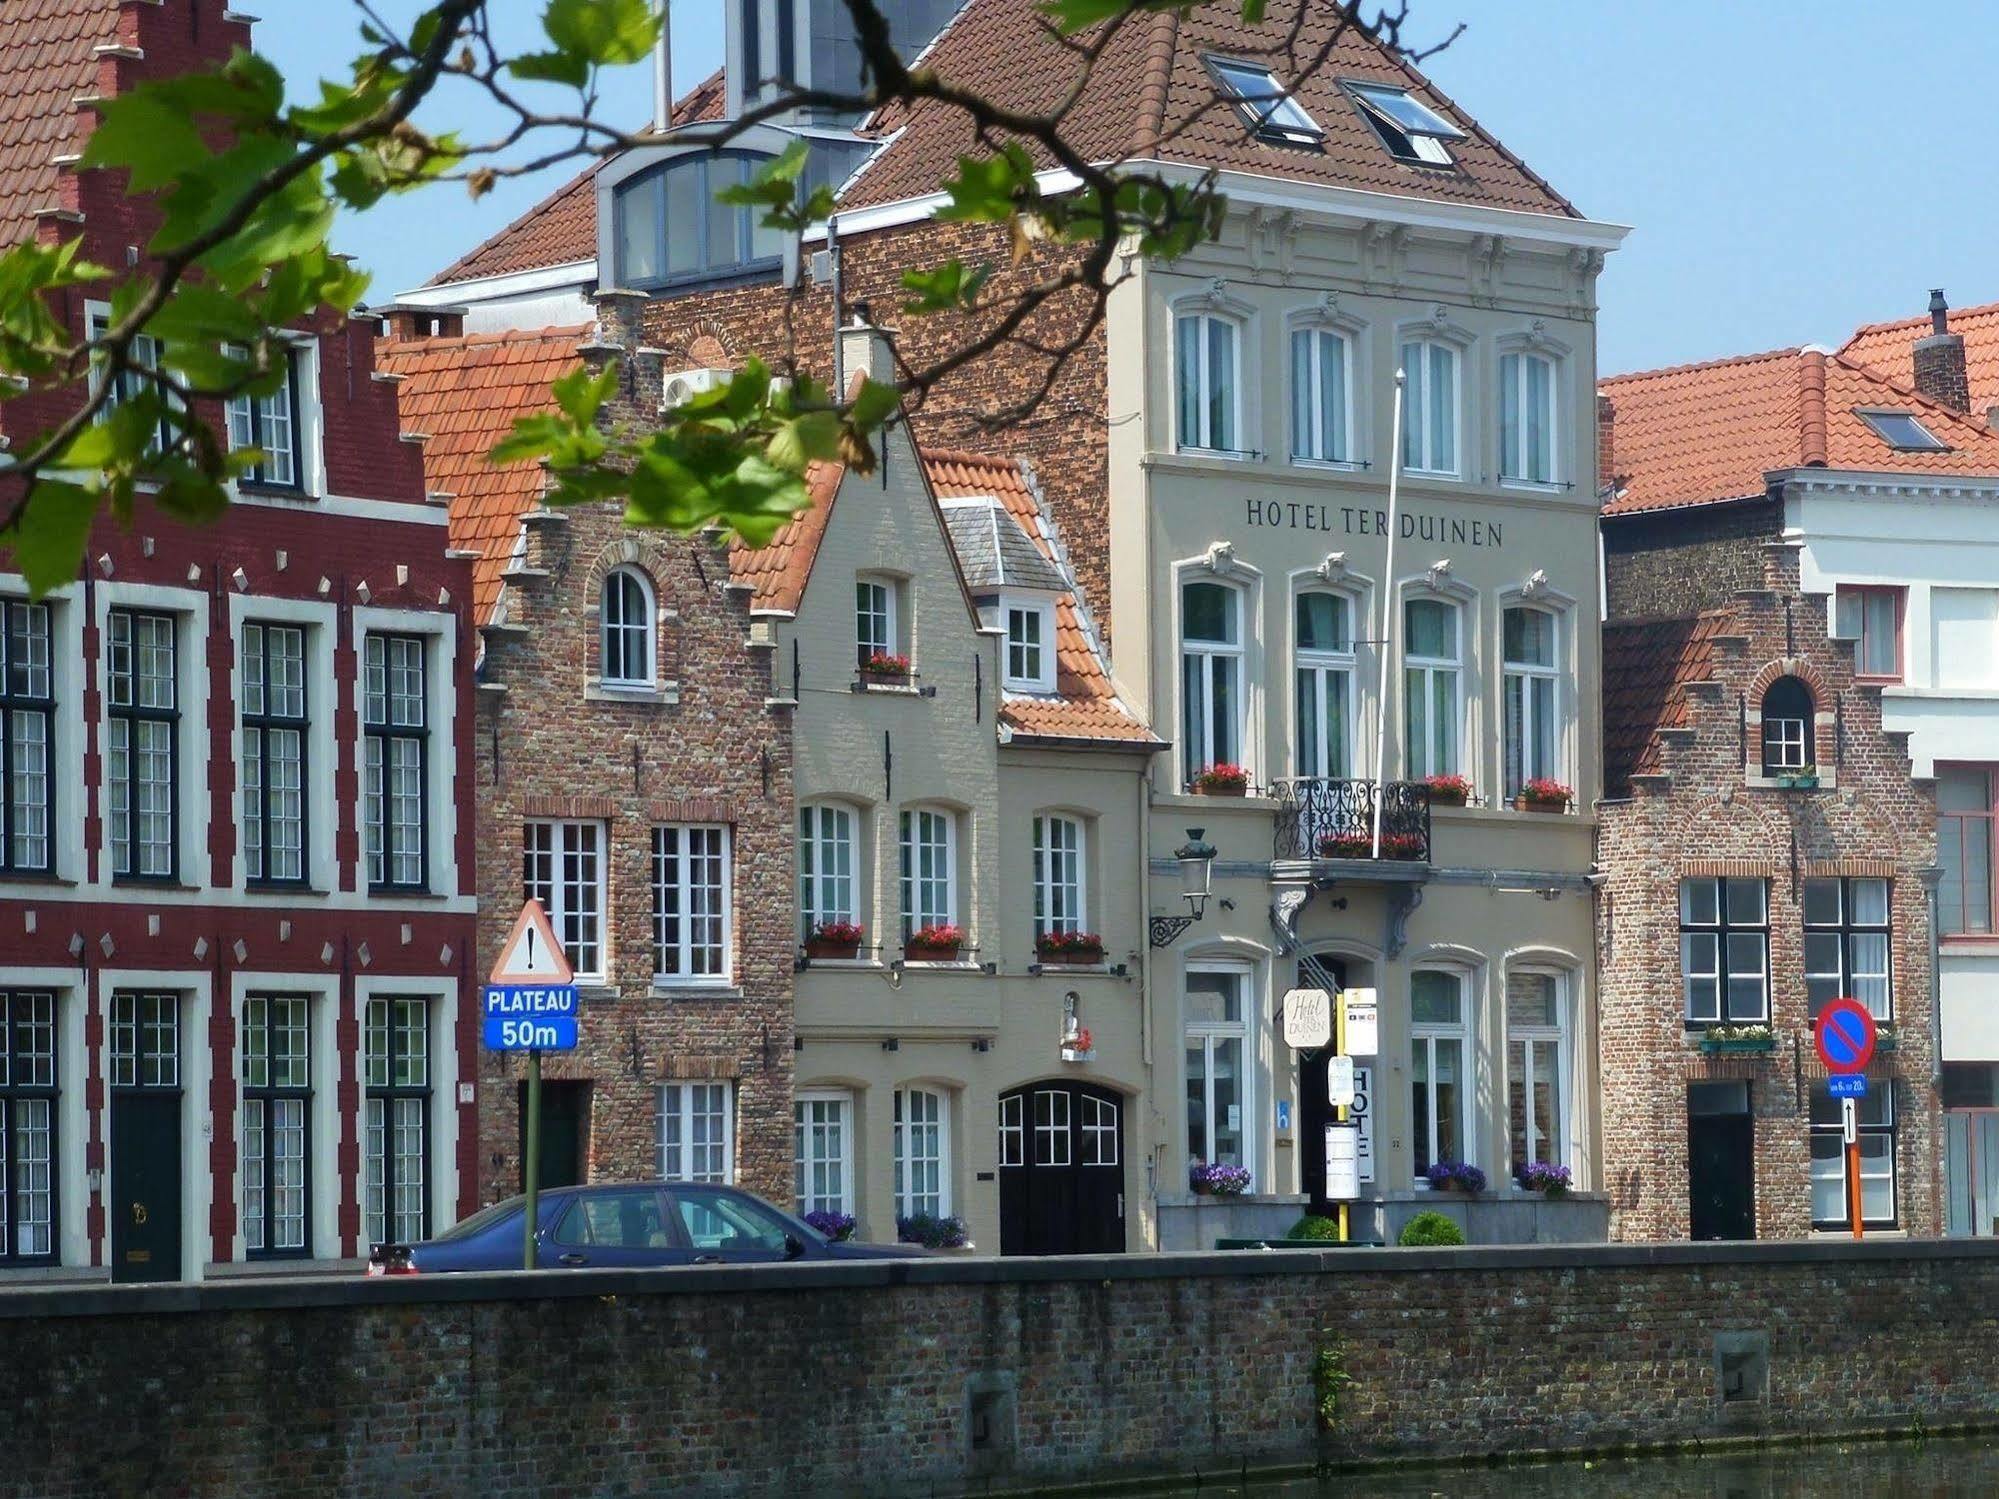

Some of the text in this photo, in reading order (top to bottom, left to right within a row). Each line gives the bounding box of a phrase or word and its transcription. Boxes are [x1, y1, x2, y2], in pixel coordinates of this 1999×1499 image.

[1246, 499, 1503, 549] HOTEL TER DUINEN
[488, 990, 572, 1012] PLATEAU
[502, 1020, 557, 1046] 50m
